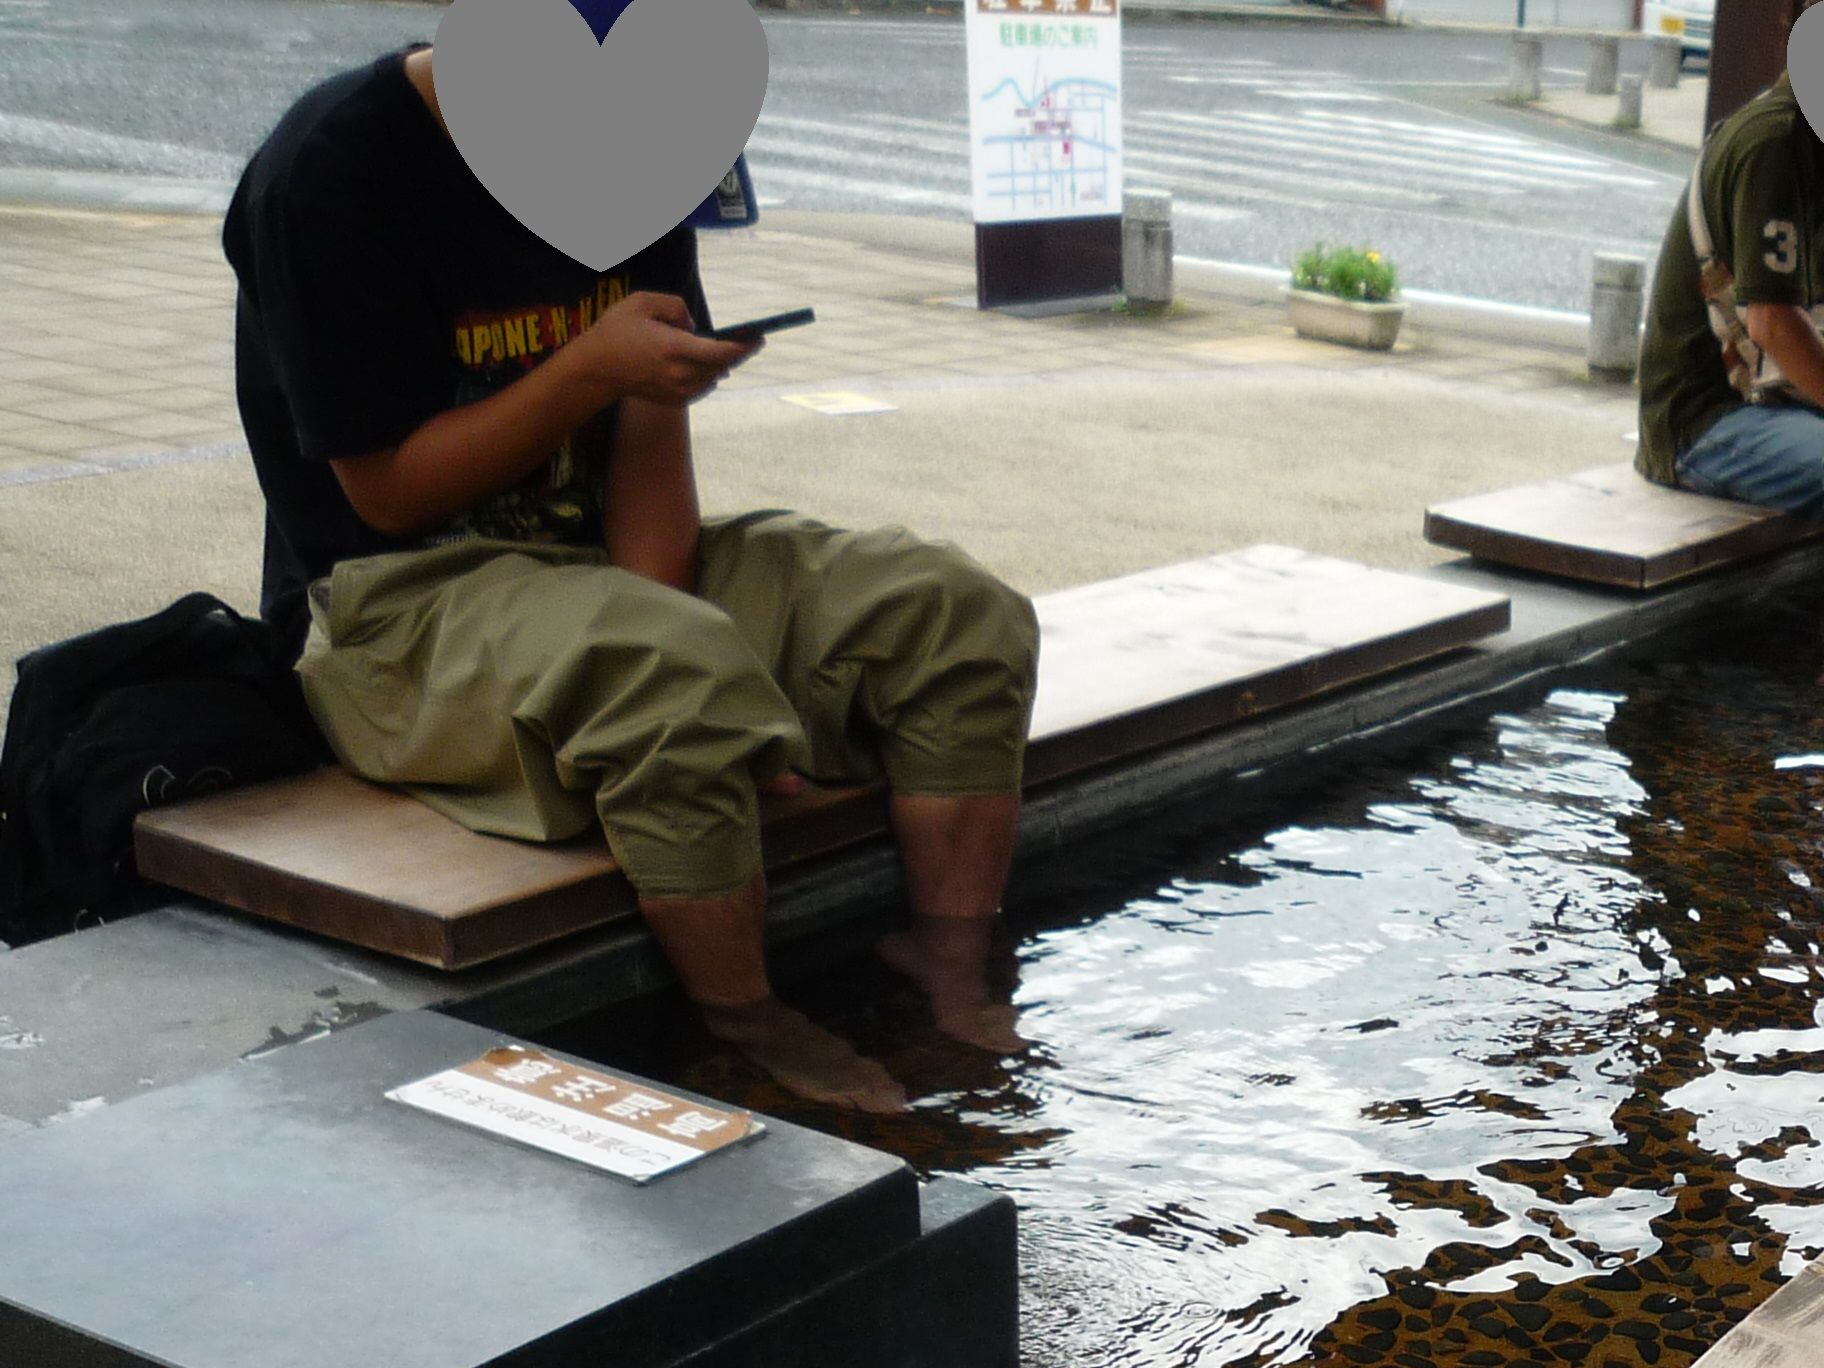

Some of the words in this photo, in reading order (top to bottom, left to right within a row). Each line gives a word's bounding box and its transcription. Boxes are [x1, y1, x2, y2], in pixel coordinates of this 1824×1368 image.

[999, 22, 1098, 48] 駐車場のご案内
[1763, 219, 1798, 274] 3
[493, 1058, 728, 1138] 高温注意
